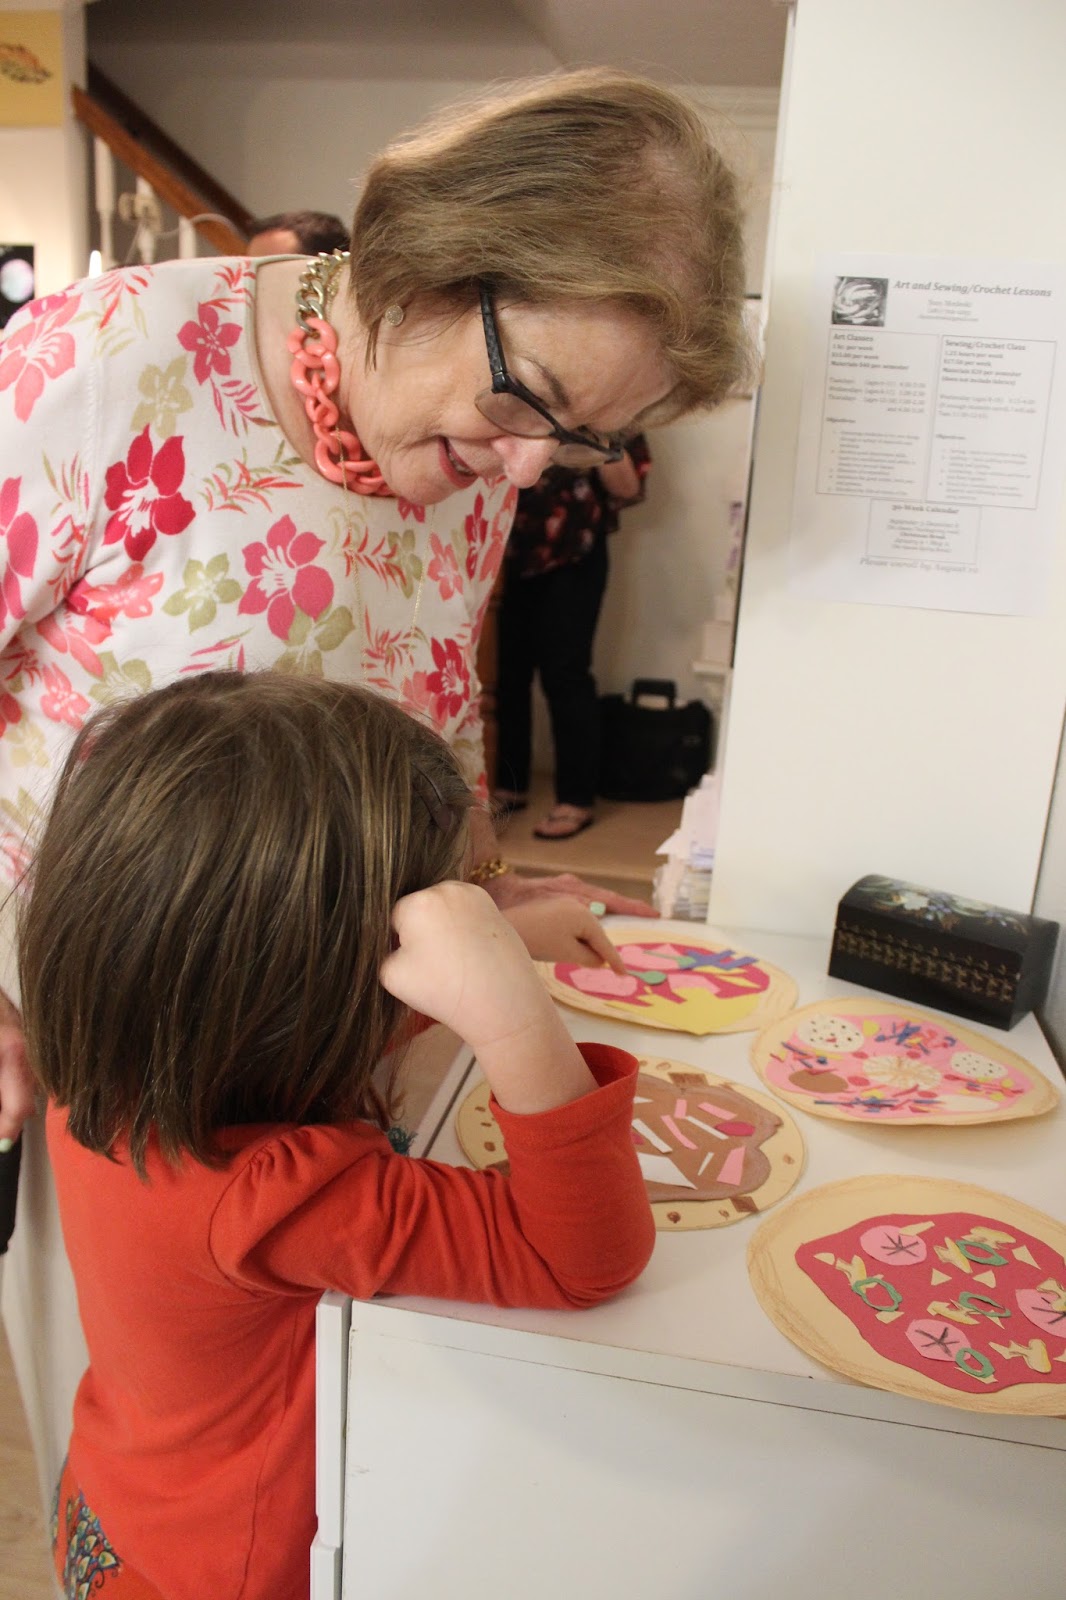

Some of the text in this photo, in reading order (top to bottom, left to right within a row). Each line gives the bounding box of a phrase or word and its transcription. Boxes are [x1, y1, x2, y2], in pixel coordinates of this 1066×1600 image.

[894, 280, 1052, 298] Art and Sewing/Crochet Lessons
[833, 333, 874, 342] Art Classes
